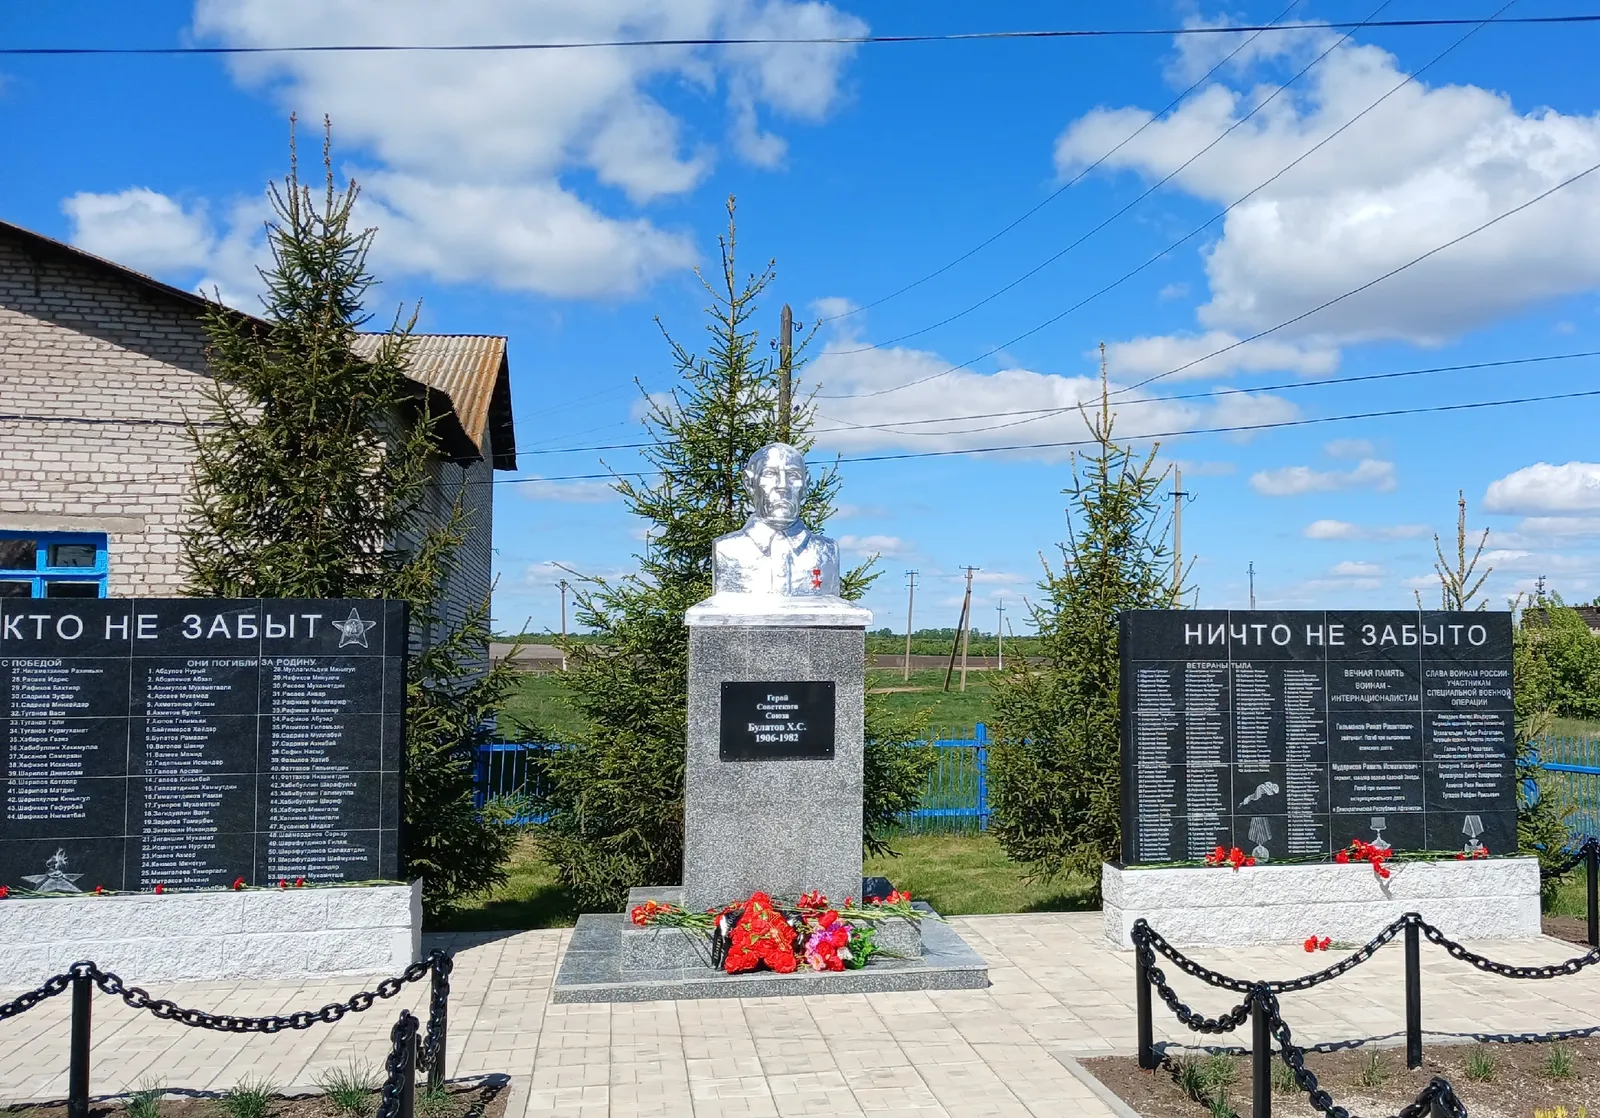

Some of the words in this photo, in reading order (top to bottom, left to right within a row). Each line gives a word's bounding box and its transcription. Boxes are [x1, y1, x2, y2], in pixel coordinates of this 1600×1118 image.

[3, 615, 83, 640] КТО
[105, 615, 158, 640] НЕ
[181, 614, 323, 640] ЗАБЫТ
[1185, 623, 1291, 646] НИЧТО
[1306, 624, 1345, 646] НЕ
[1362, 624, 1487, 646] ЗАБЫТО
[12, 659, 62, 667] ПОБЕДОЙ
[1427, 688, 1476, 697] СПЕЦИАЛЬНОЙ
[767, 695, 788, 703] Герой
[748, 723, 785, 733] Булатов
[756, 734, 798, 742] 1906-1982
